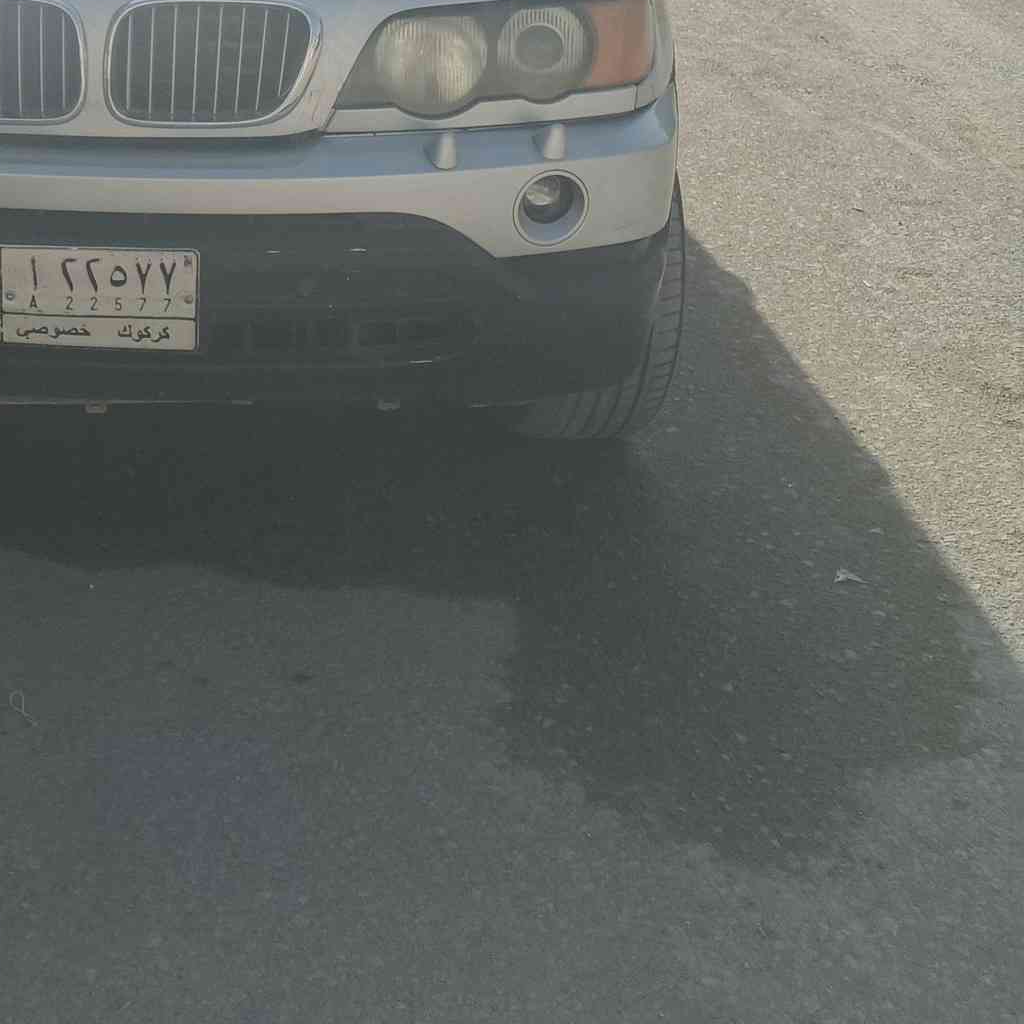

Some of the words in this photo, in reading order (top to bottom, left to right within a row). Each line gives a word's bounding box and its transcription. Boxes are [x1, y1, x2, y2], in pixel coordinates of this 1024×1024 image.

[61, 258, 177, 294] ٢٢٥٧٧
[29, 295, 38, 308] A
[65, 296, 172, 312] 22577
[16, 322, 91, 340] خصوصي
[117, 324, 171, 343] كركوك
